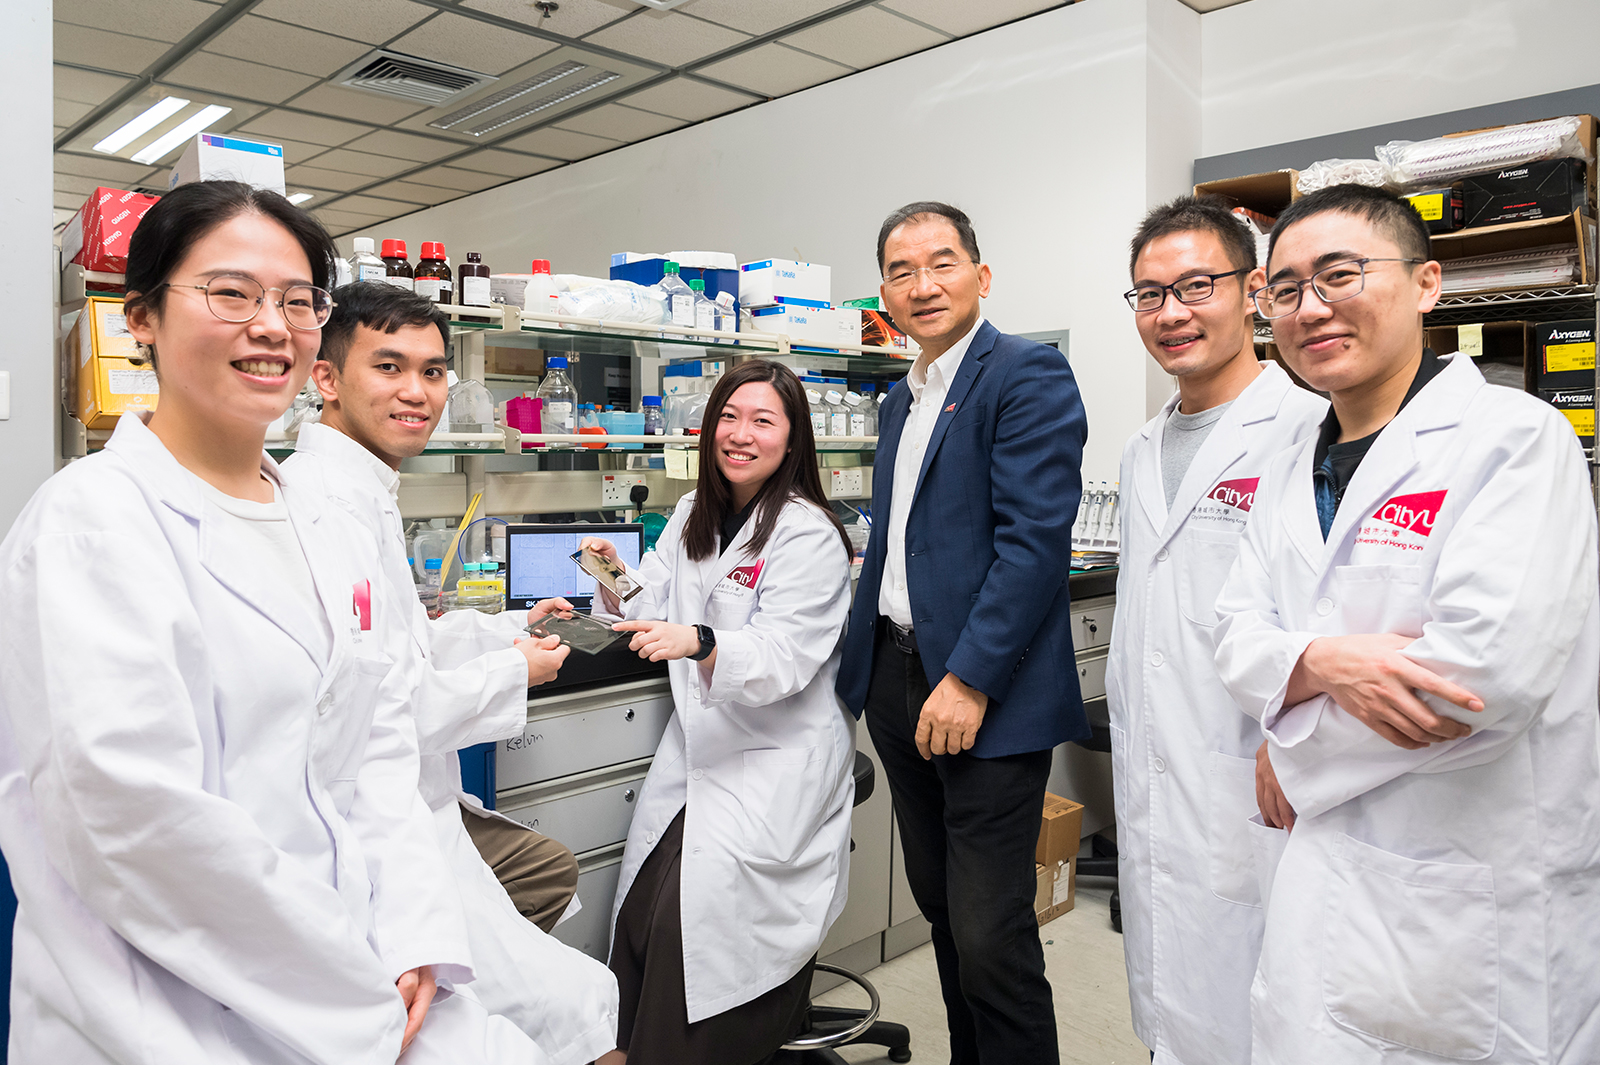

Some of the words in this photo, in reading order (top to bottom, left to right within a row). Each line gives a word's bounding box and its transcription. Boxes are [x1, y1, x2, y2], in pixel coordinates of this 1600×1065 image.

[1498, 168, 1529, 179] AXYGEN
[111, 209, 131, 224] QIAGEN
[102, 230, 122, 246] QIAGEN
[1548, 329, 1590, 340] AXYGEN
[1551, 393, 1592, 403] AXYGEN
[1381, 504, 1438, 530] CityU
[1389, 541, 1407, 550] Hong
[506, 732, 544, 752] Kelvin
